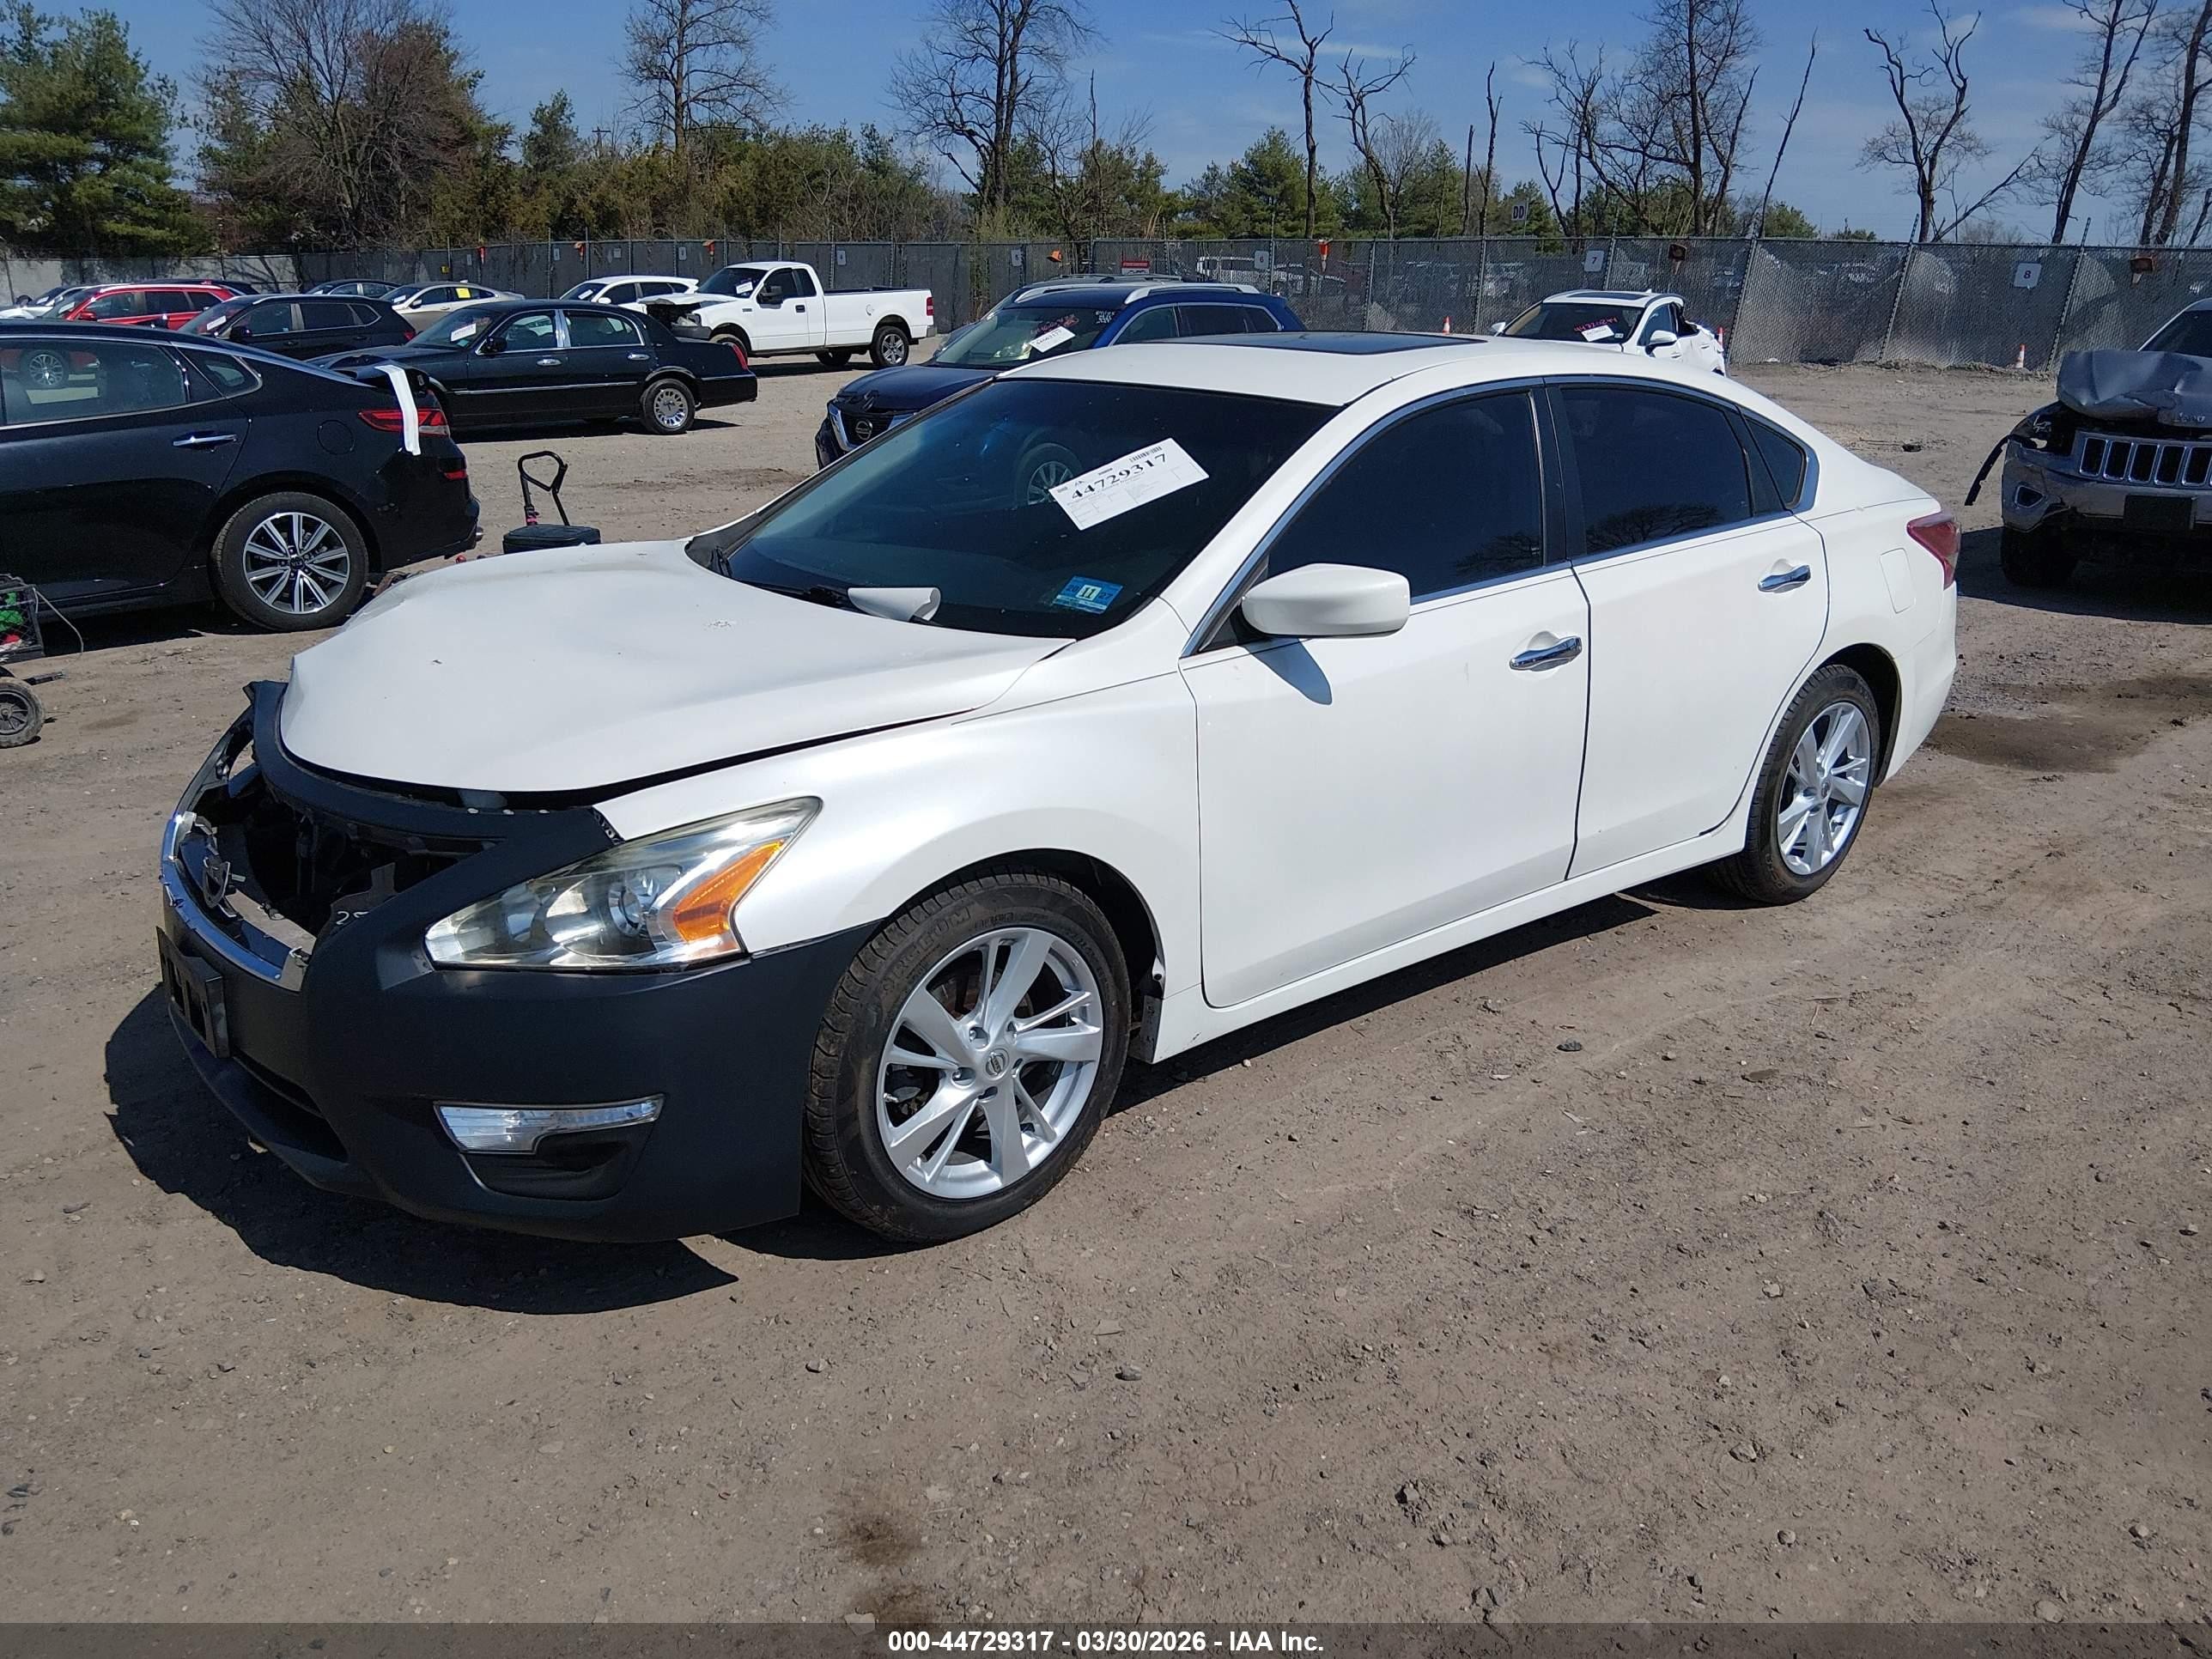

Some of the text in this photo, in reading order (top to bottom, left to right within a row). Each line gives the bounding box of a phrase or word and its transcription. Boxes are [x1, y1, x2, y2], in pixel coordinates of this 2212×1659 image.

[1513, 205, 1525, 220] DD
[1592, 256, 1597, 264] 7
[2023, 270, 2032, 279] 8
[1072, 453, 1167, 500] 44729317
[1079, 586, 1096, 599] 11
